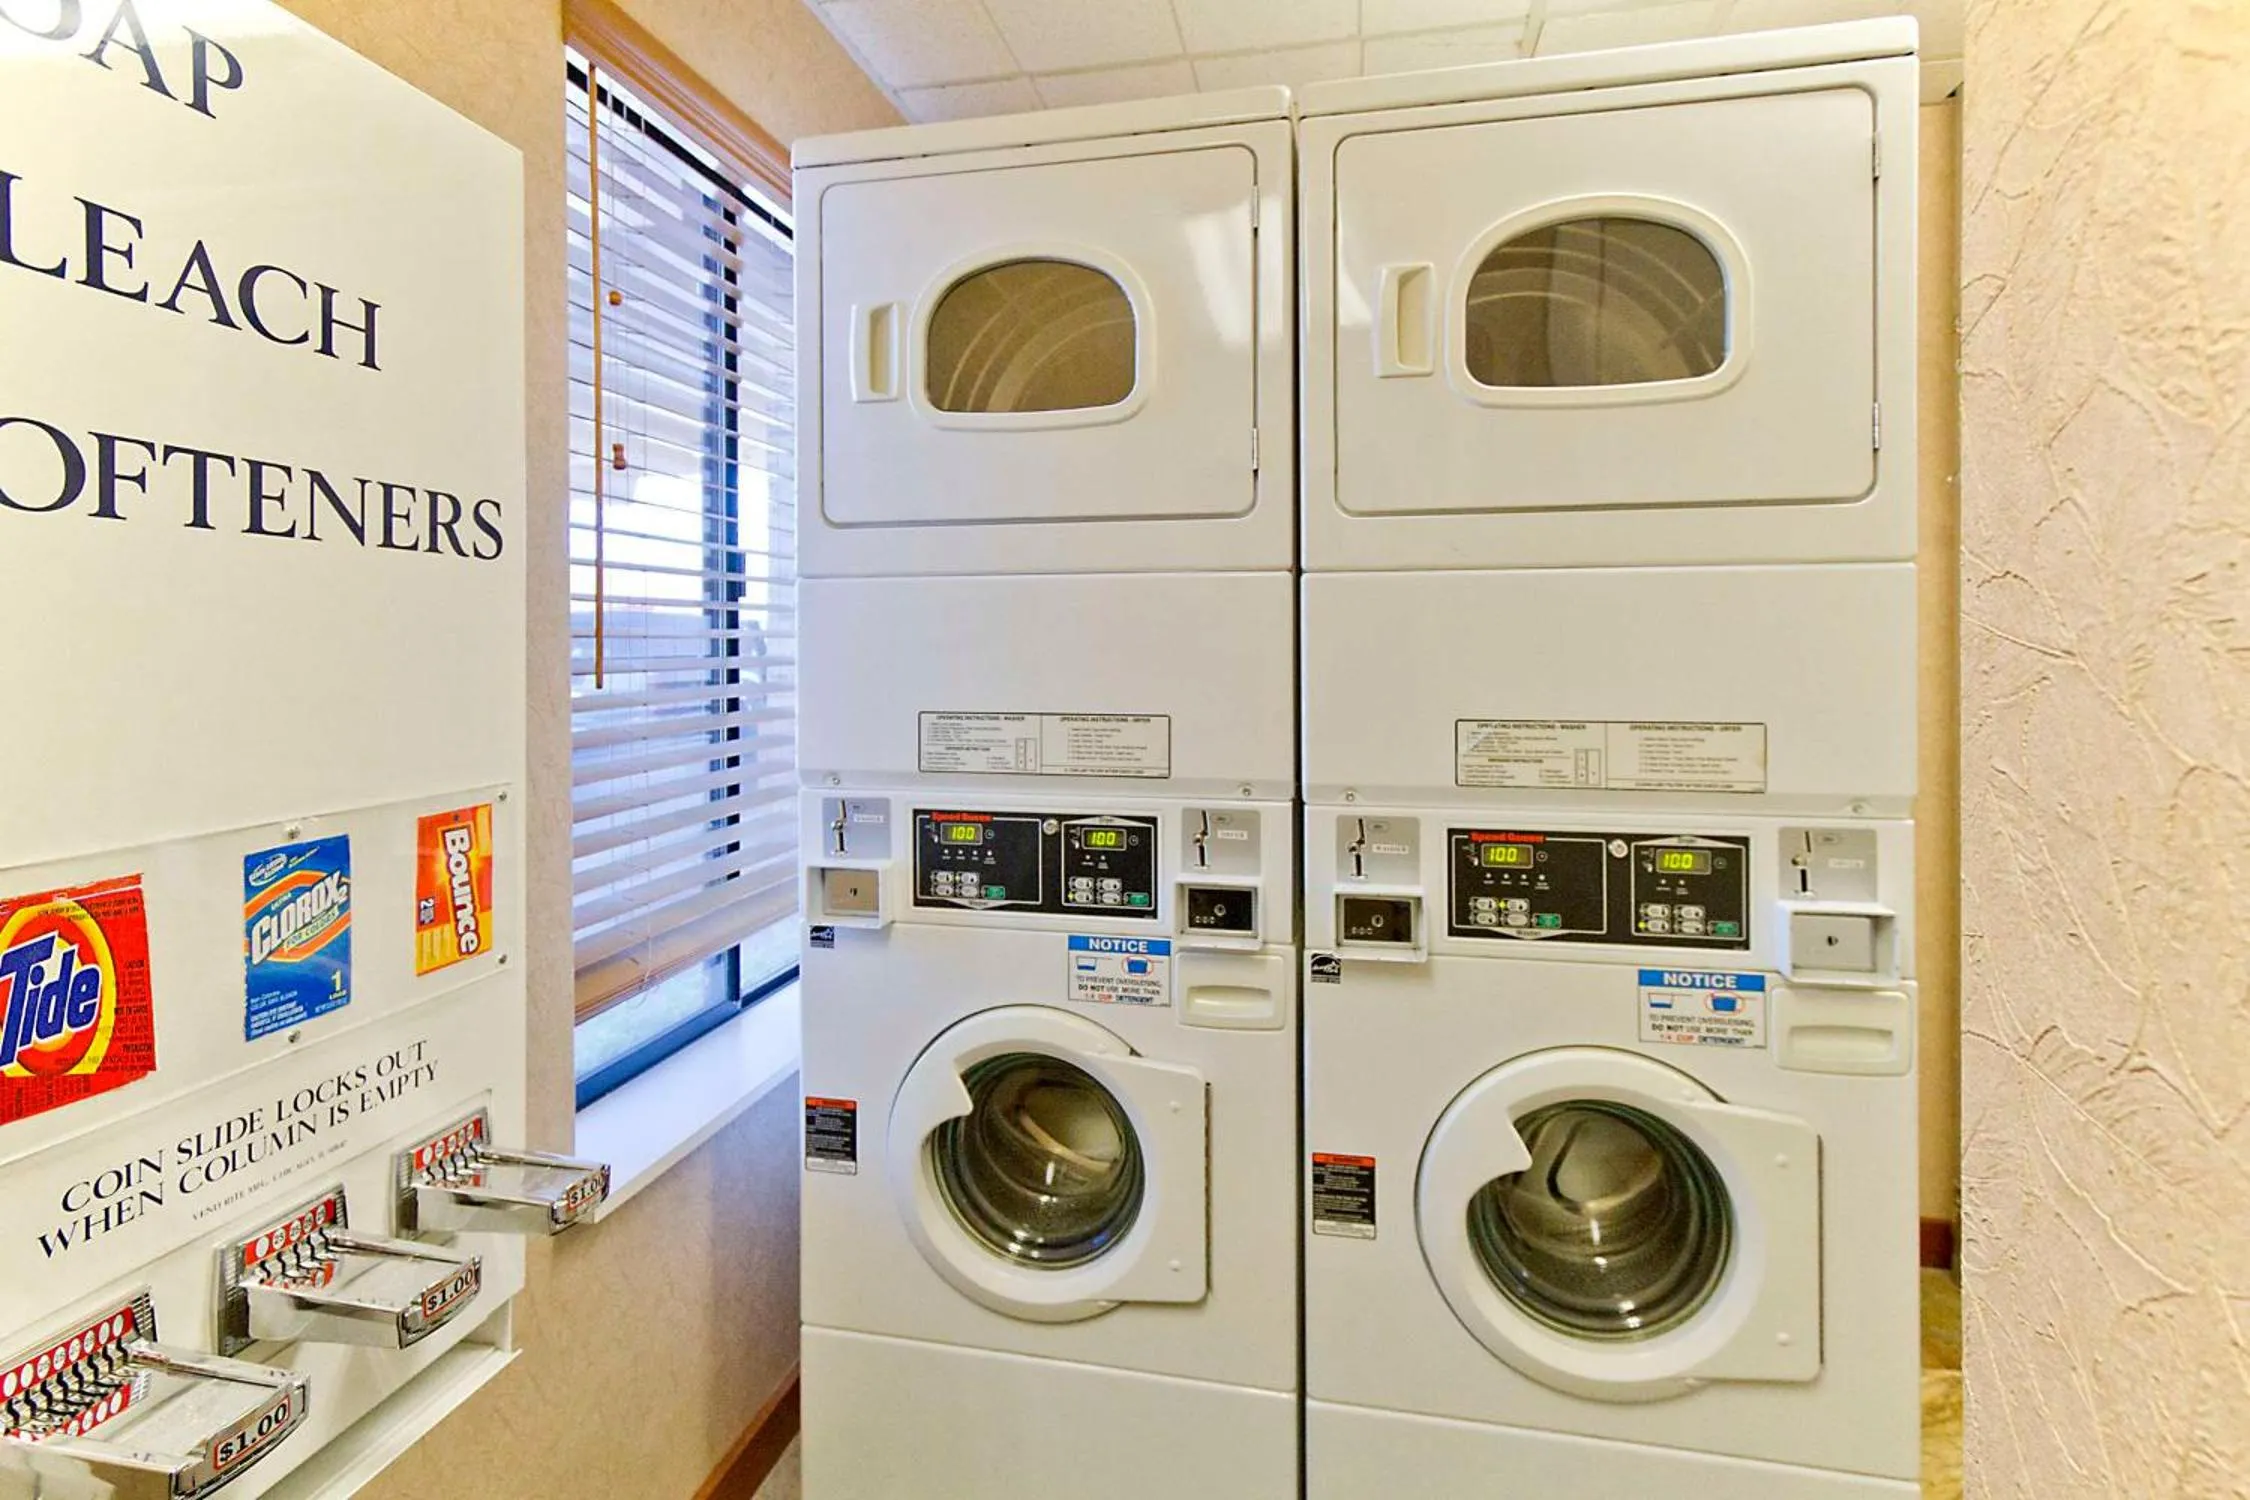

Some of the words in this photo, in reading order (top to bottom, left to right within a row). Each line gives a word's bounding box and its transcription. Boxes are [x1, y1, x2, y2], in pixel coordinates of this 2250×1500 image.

[0, 417, 503, 560] OFTENERS
[952, 826, 976, 840] 100
[1091, 831, 1116, 846] 100
[1489, 847, 1518, 863] 100
[1663, 853, 1693, 869] 100
[444, 829, 479, 954] Bounce
[251, 870, 341, 965] CLOROX
[1088, 938, 1148, 953] NOTICE
[1122, 986, 1140, 994] MORE
[1663, 972, 1738, 988] NOTICE
[0, 934, 101, 1068] Tide
[1652, 1023, 1664, 1031] DO
[1667, 1024, 1683, 1032] NOT
[62, 1150, 164, 1213] COIN
[177, 1108, 264, 1166] SLIDE
[276, 1068, 367, 1123] LOCKS
[376, 1038, 429, 1073] OUT
[37, 1181, 164, 1259] WHEN
[179, 1113, 318, 1195] COLUMN
[329, 1098, 350, 1129] IS
[359, 1058, 440, 1114] EMPTY
[428, 1265, 475, 1314] $1.00
[218, 1402, 288, 1463] $1.00
